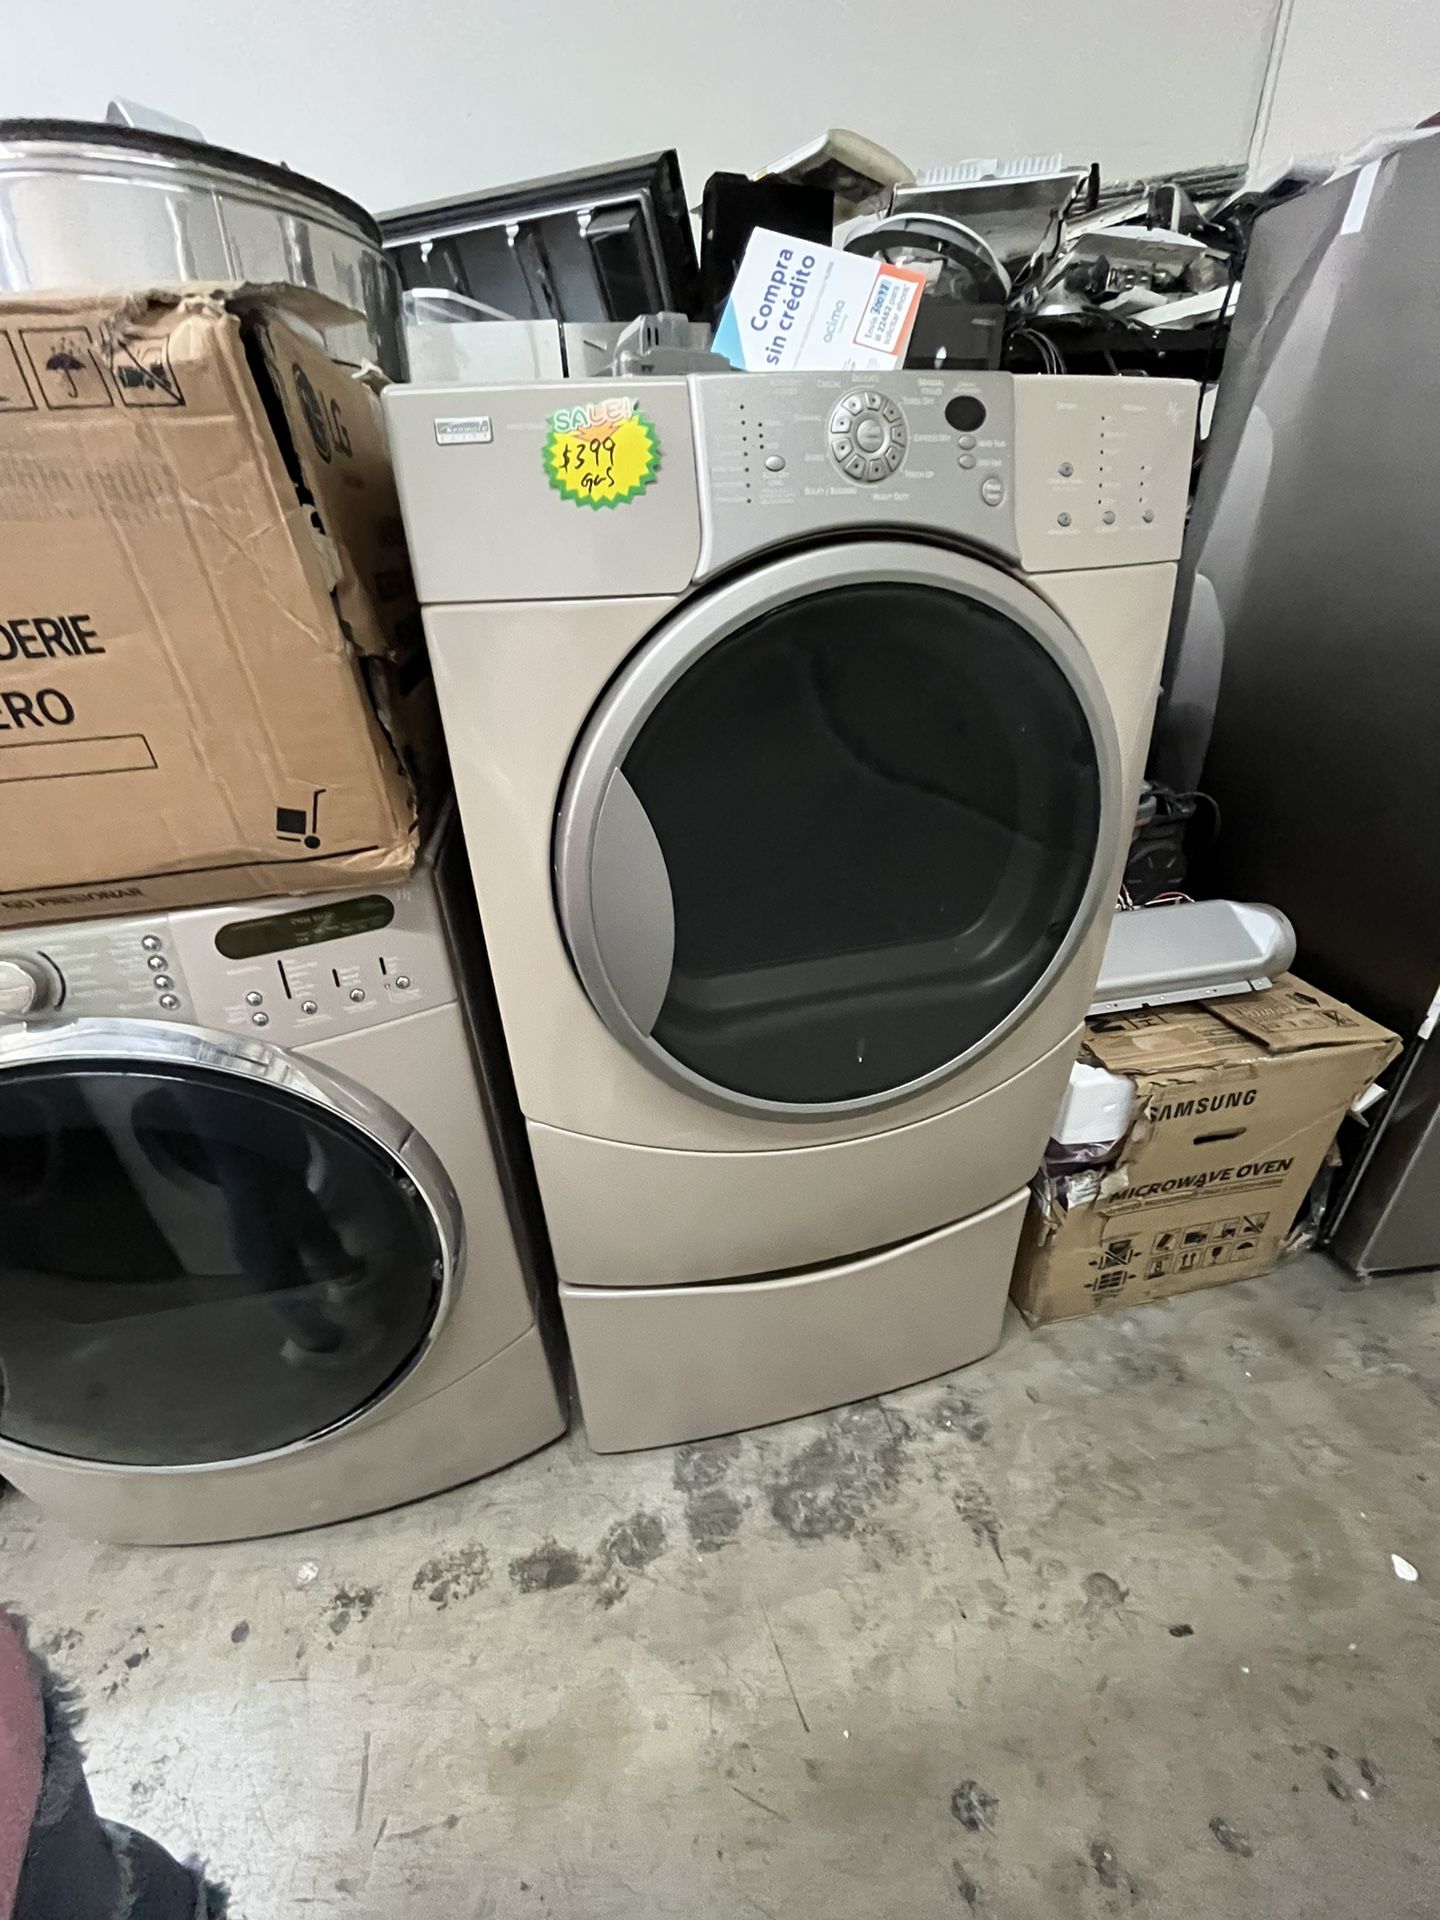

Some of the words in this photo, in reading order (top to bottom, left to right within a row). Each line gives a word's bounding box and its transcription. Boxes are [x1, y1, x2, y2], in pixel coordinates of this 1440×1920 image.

[751, 249, 794, 332] Compra
[766, 335, 788, 366] sin
[779, 255, 816, 331] crédito
[823, 299, 846, 343] acima
[553, 396, 632, 433] SALE!
[559, 437, 617, 472] $399
[1149, 1088, 1258, 1123] SAMSUNG
[1108, 1167, 1235, 1204] MICROWAVE
[1235, 1156, 1296, 1180] OVEN
